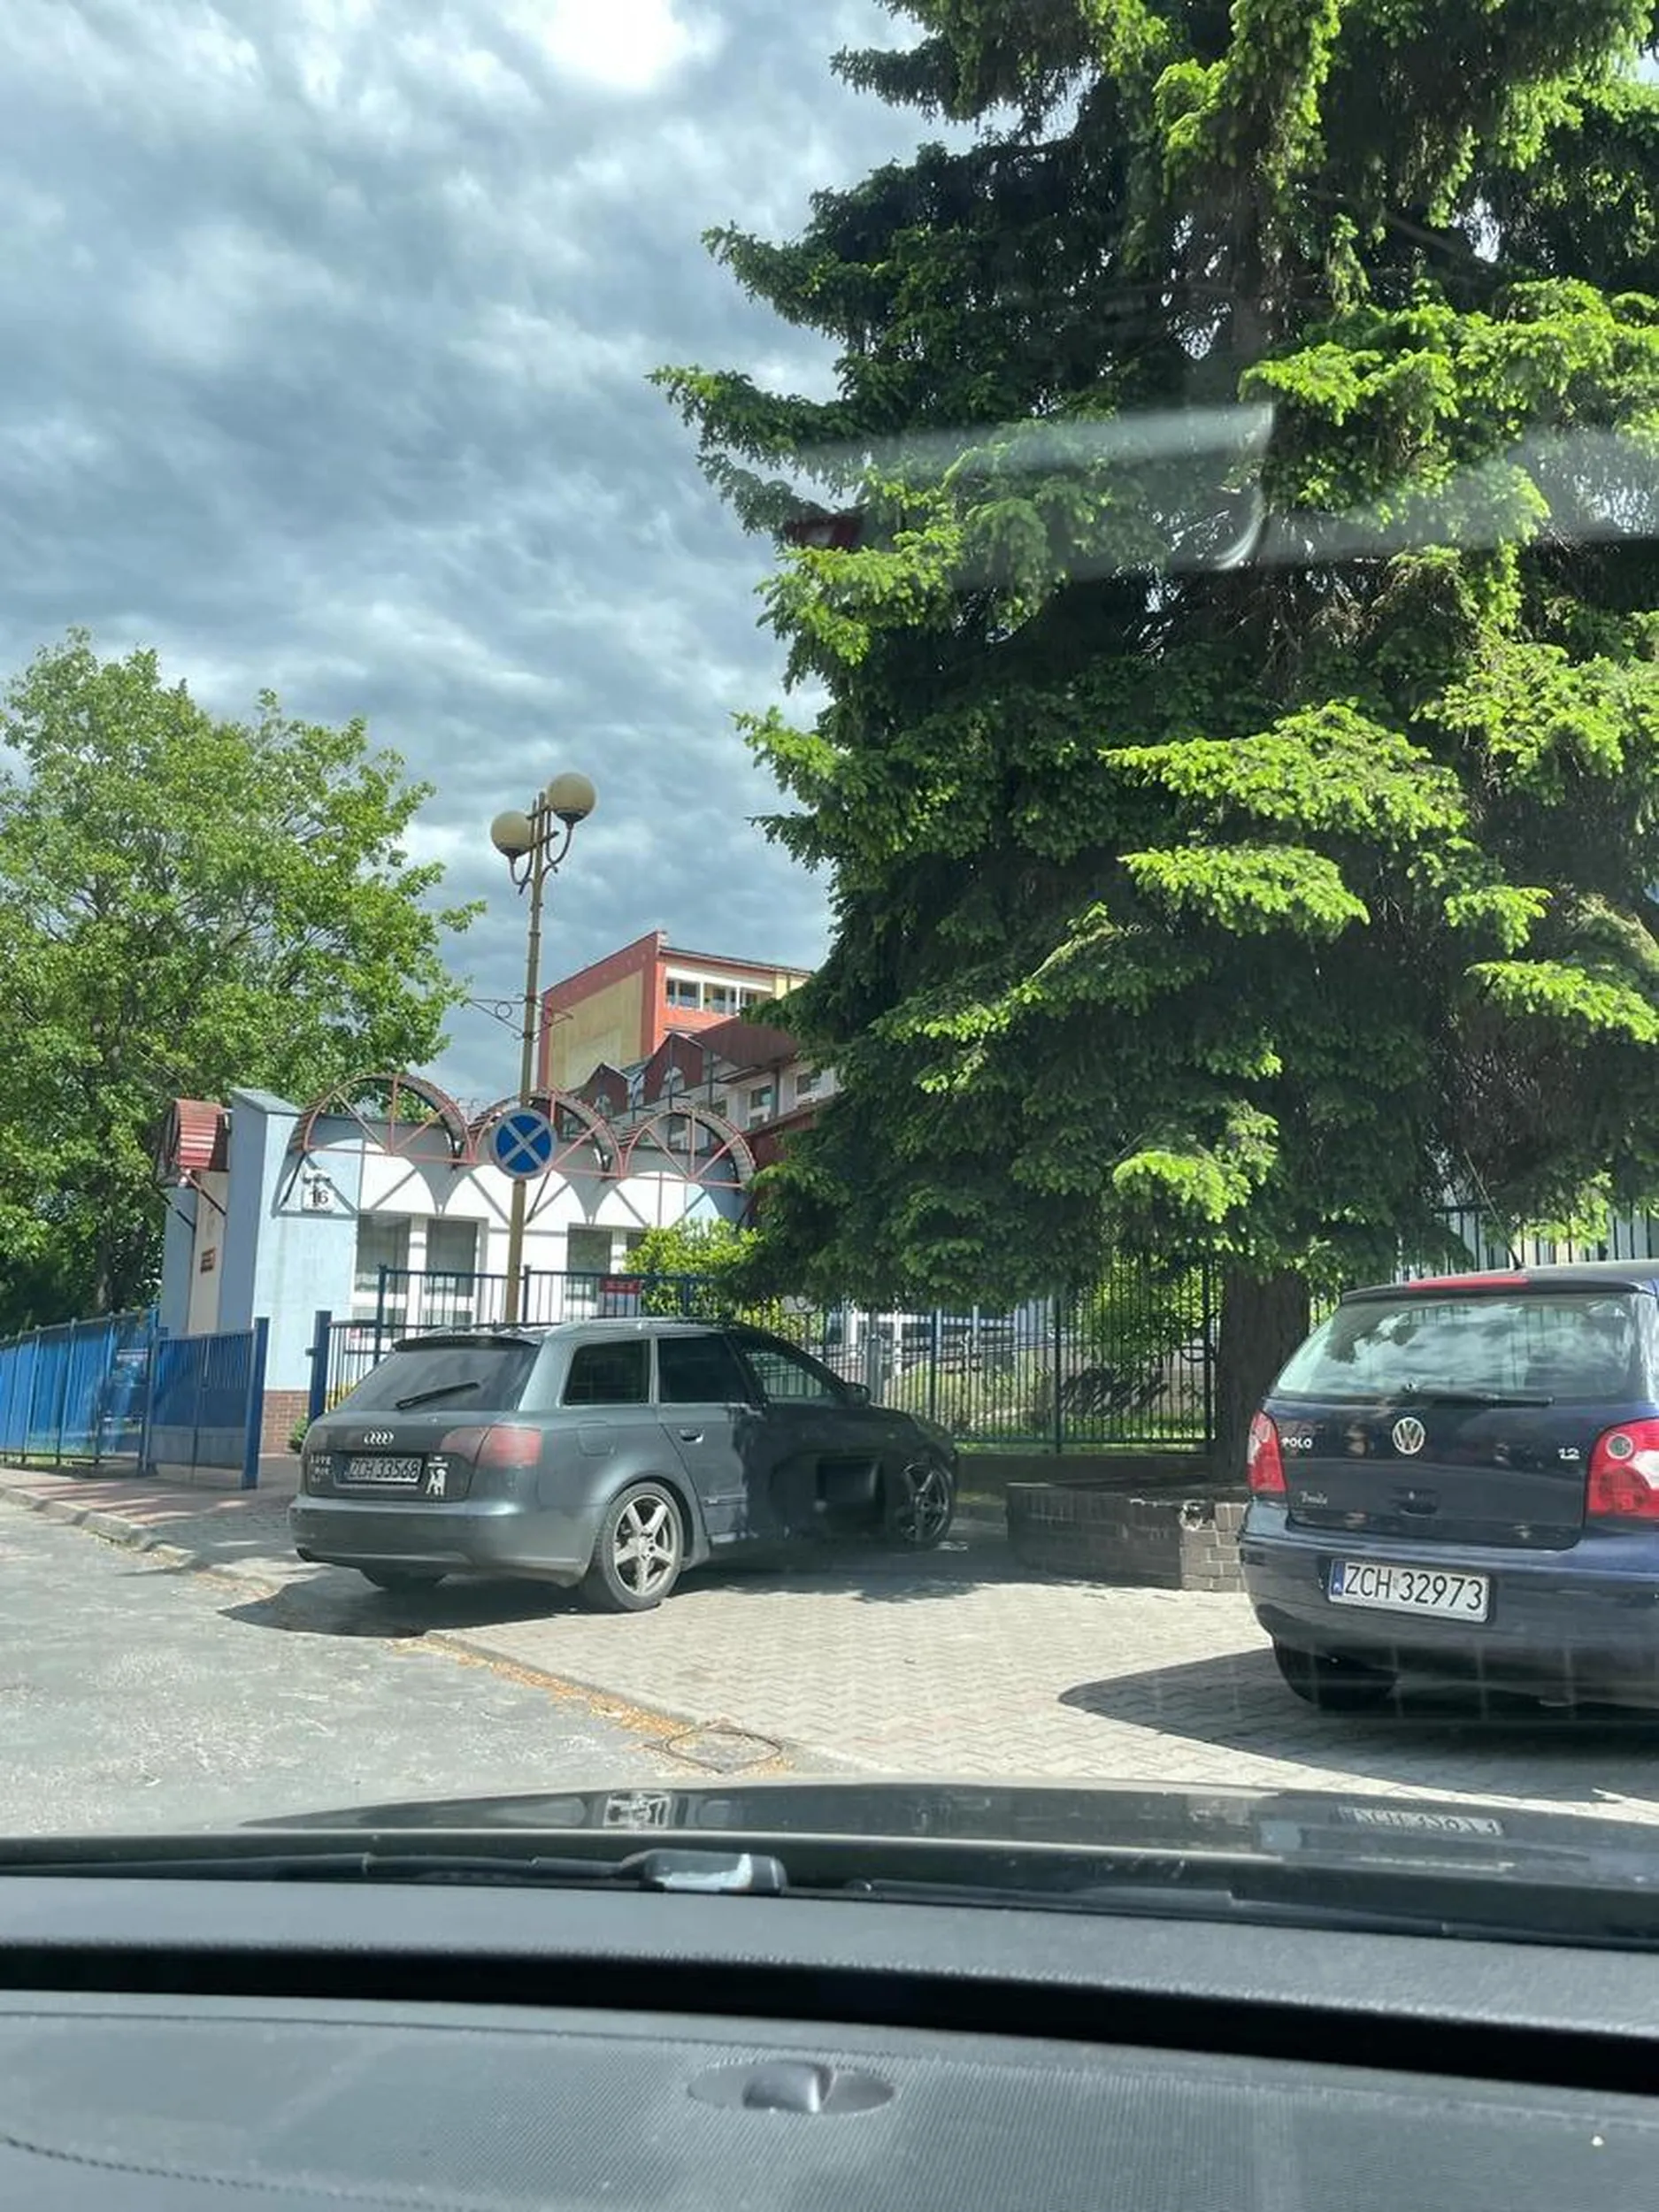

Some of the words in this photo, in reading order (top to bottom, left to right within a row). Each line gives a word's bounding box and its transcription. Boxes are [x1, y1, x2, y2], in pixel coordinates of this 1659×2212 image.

[1281, 1437, 1312, 1449] POLO
[1345, 1565, 1392, 1599] ZCH
[1399, 1571, 1483, 1610] 32973
